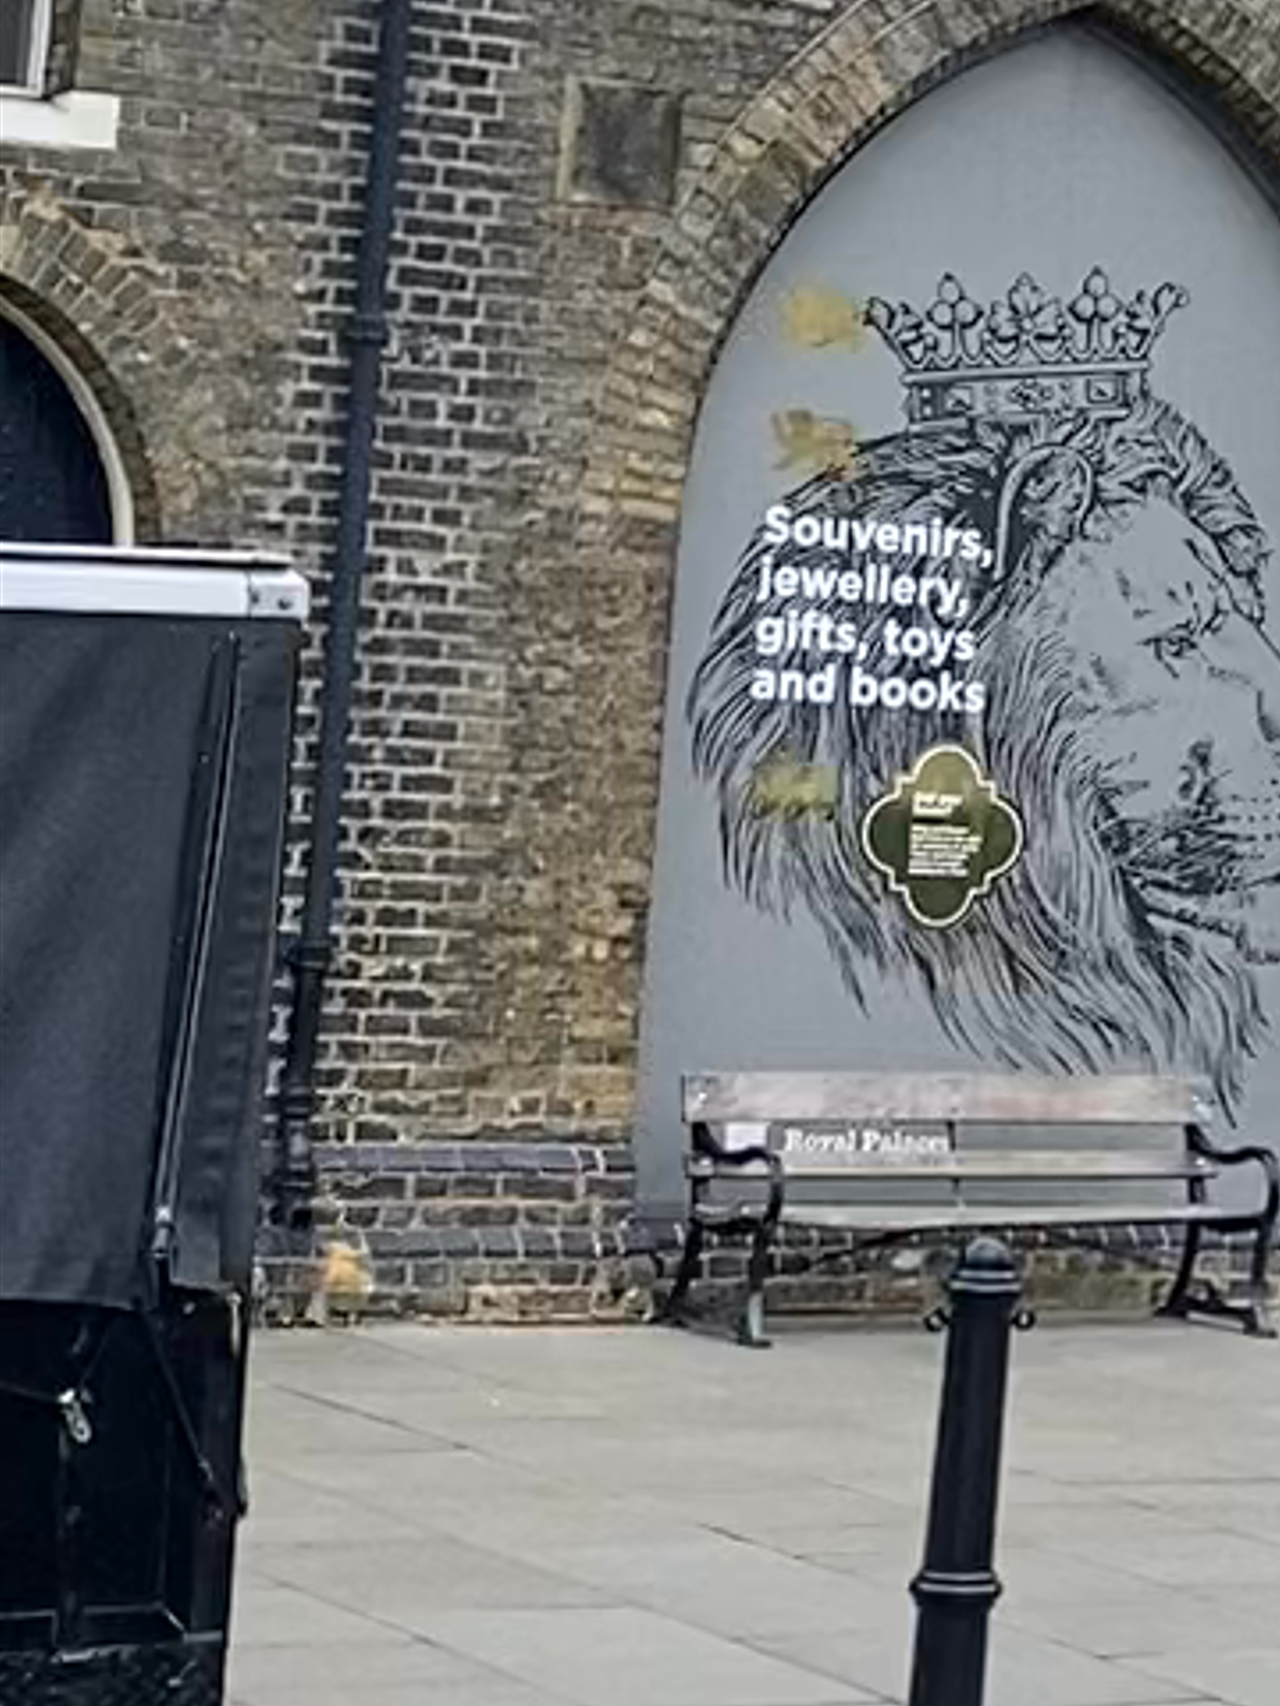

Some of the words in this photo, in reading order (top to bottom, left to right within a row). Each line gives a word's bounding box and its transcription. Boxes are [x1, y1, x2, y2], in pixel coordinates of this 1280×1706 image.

[763, 504, 993, 568] Souvenirs,
[756, 555, 970, 619] jewellery,
[755, 608, 868, 661] gifts,
[884, 617, 976, 667] toys
[750, 663, 837, 705] and
[850, 666, 986, 714] books
[784, 1127, 857, 1154] Royal
